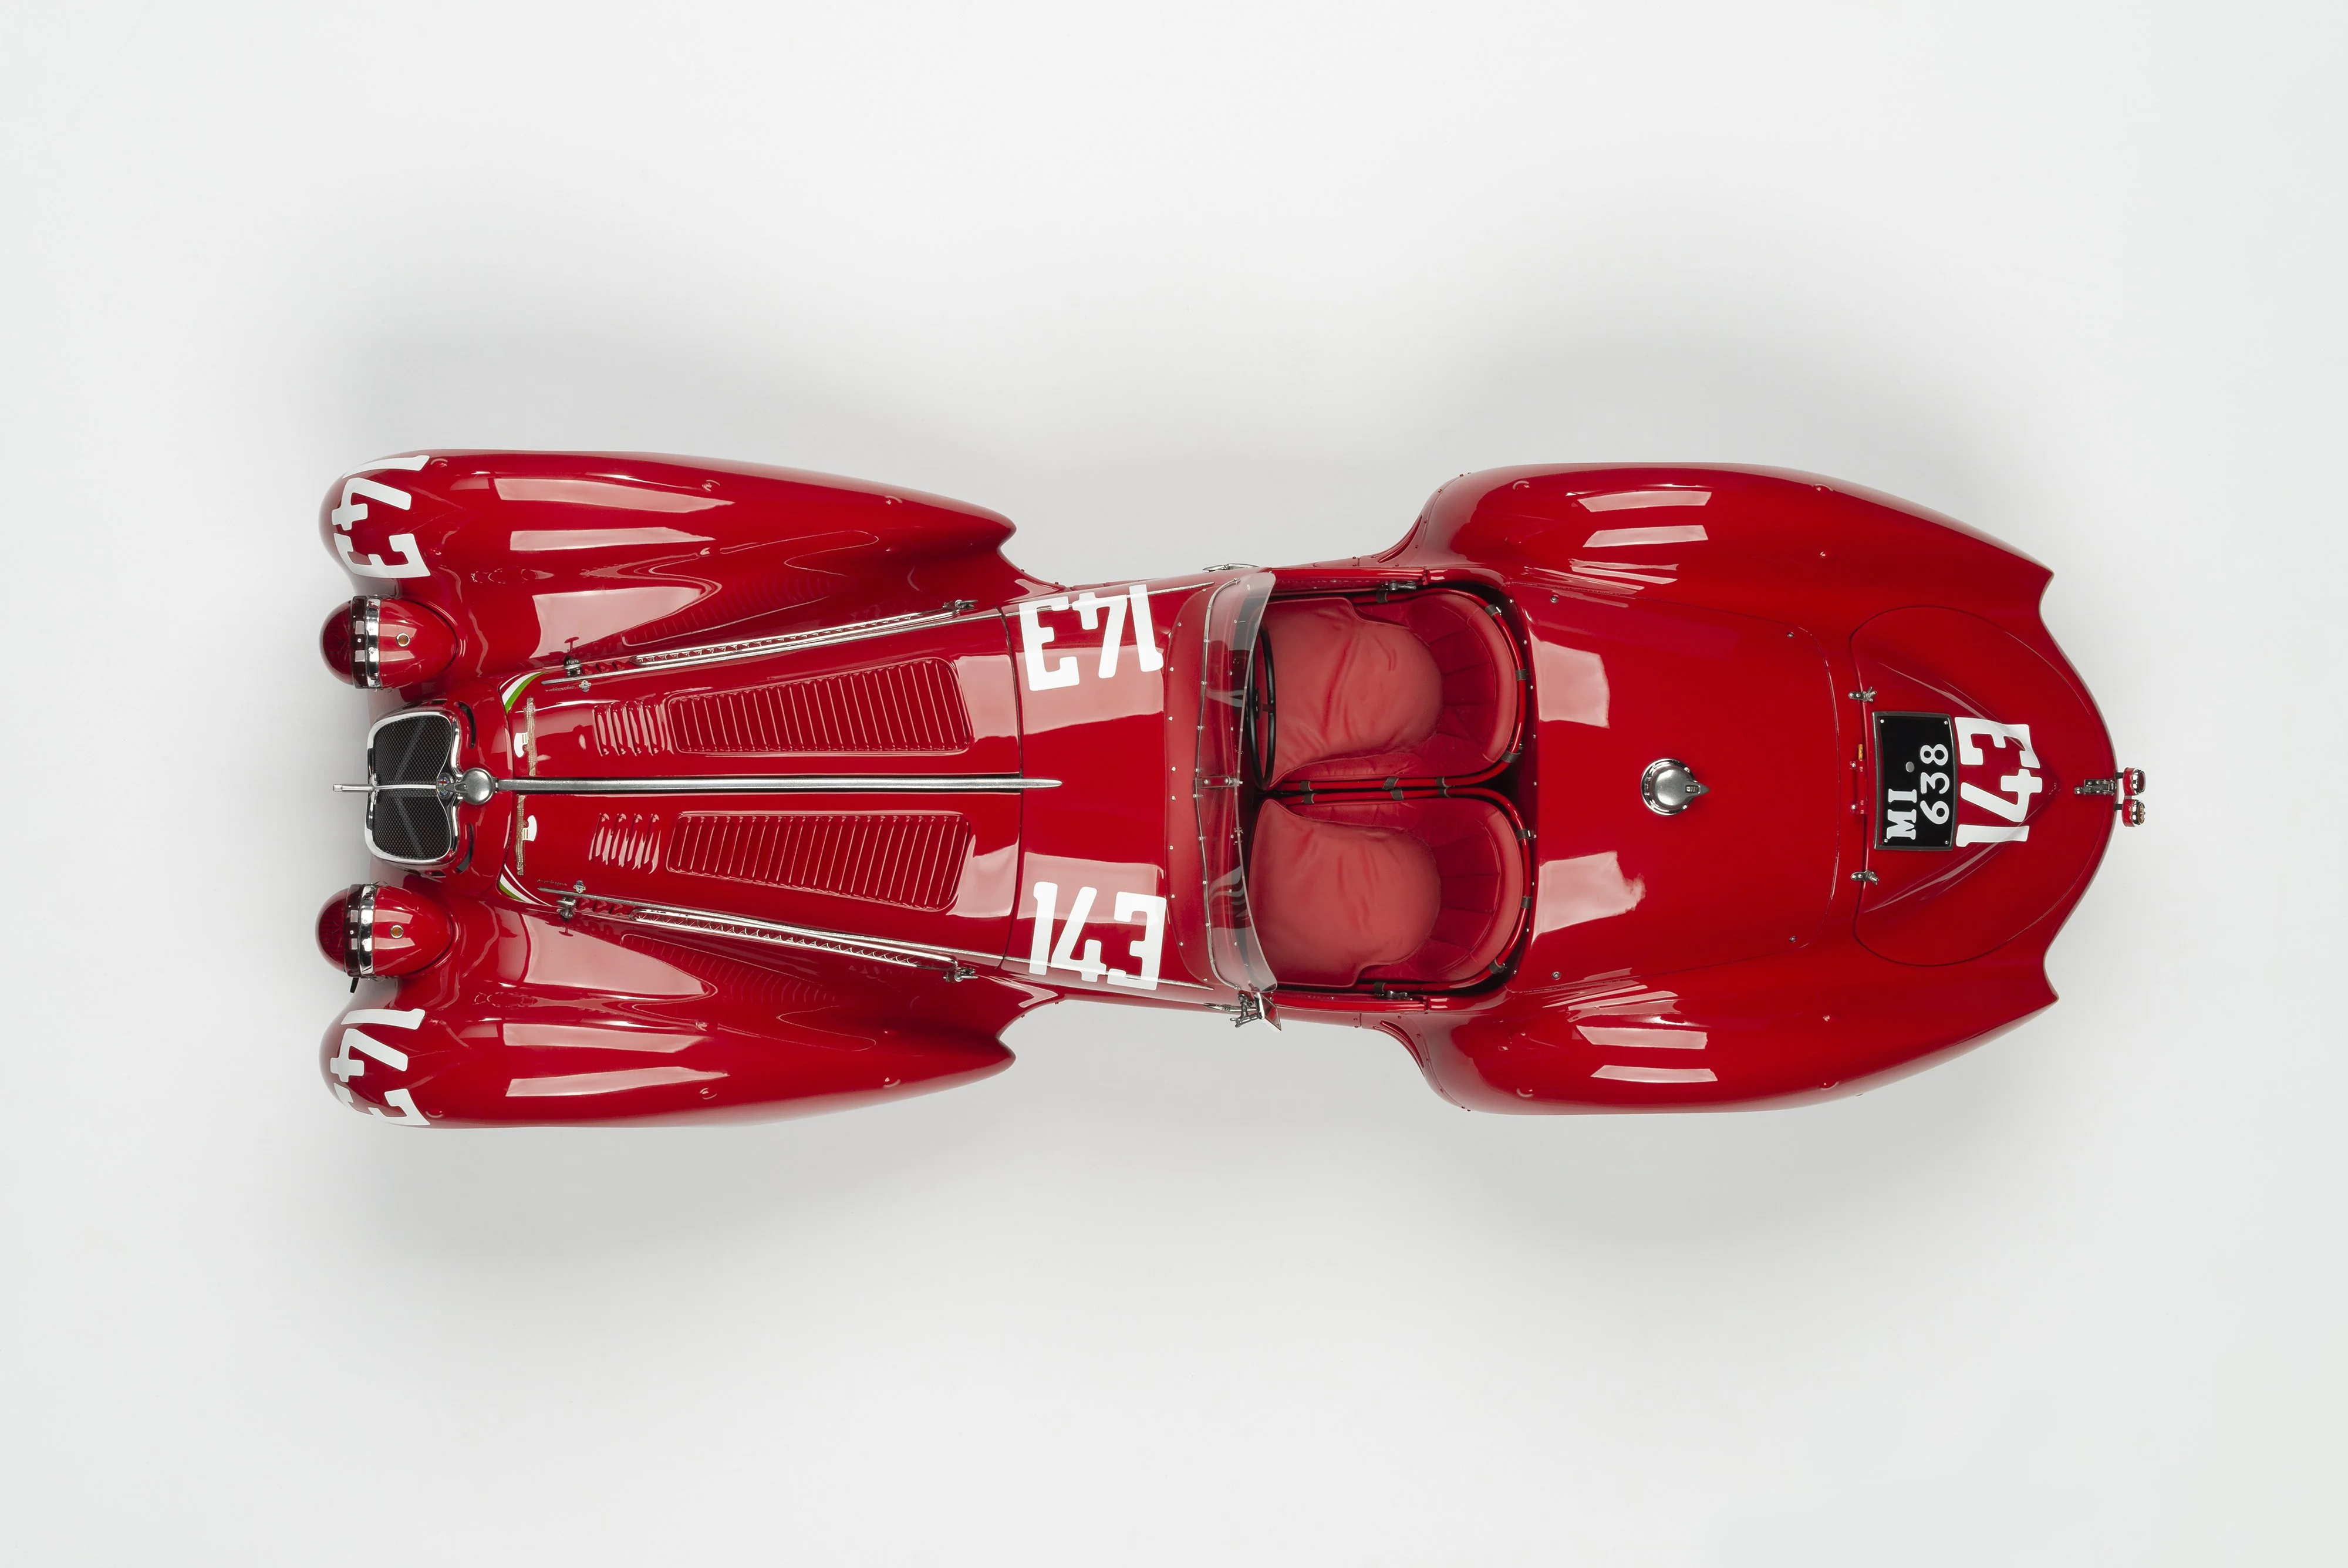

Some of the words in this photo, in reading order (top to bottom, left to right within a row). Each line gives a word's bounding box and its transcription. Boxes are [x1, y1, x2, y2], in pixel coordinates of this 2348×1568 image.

[332, 455, 430, 578] 143
[1018, 584, 1163, 692] 143
[1886, 788, 1917, 840] MI
[1919, 744, 1950, 825] 638
[1954, 717, 2043, 847] 143
[1029, 881, 1167, 990] 143
